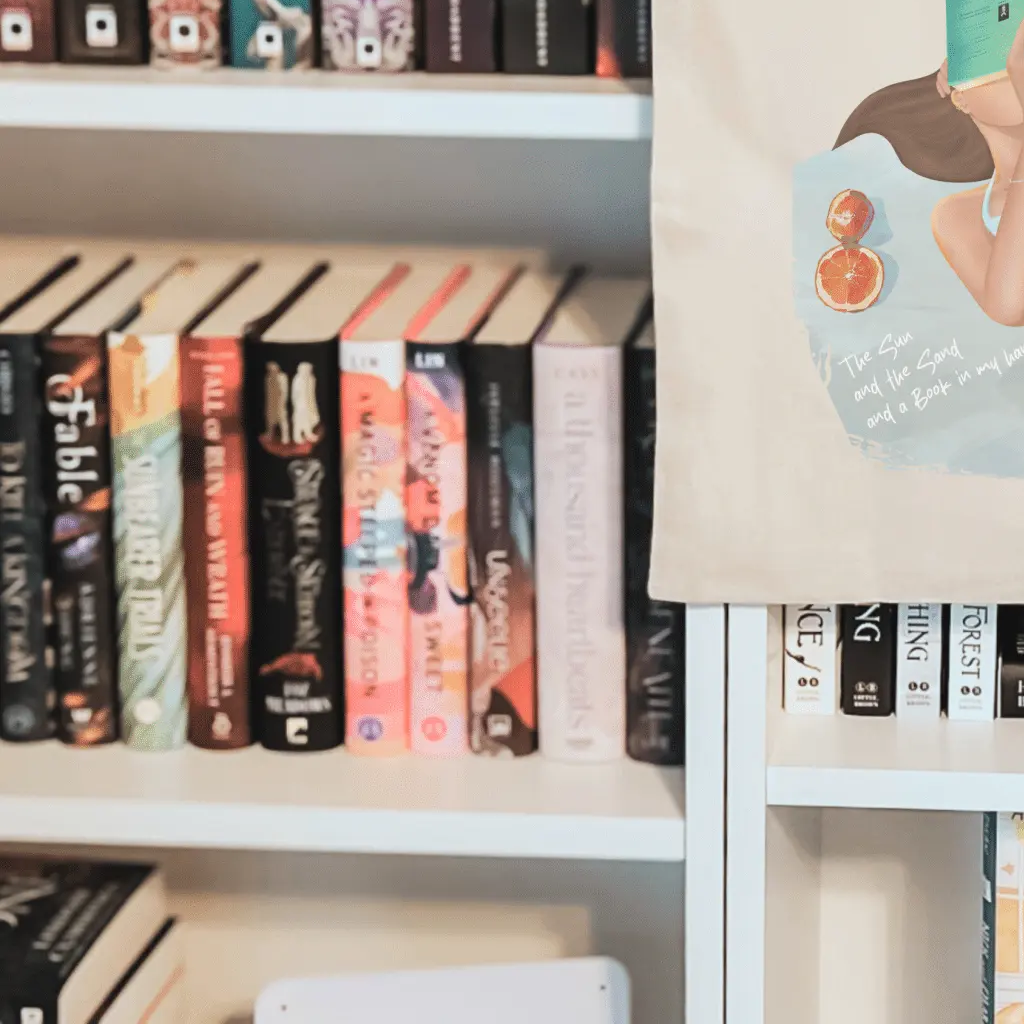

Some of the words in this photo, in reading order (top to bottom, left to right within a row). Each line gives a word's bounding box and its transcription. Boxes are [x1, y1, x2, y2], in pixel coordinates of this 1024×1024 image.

[201, 364, 226, 414] FALL
[415, 353, 446, 368] LIN
[838, 350, 873, 378] The
[878, 331, 914, 360] Sun
[854, 376, 884, 402] and
[885, 364, 912, 392] the
[916, 337, 964, 375] Sand
[866, 402, 897, 429] and
[898, 401, 909, 414] a
[911, 378, 952, 411] Book
[955, 369, 972, 387] in
[975, 356, 1003, 377] my
[46, 374, 99, 504] Fable
[564, 418, 596, 563] thousand
[957, 605, 989, 680] FOREST
